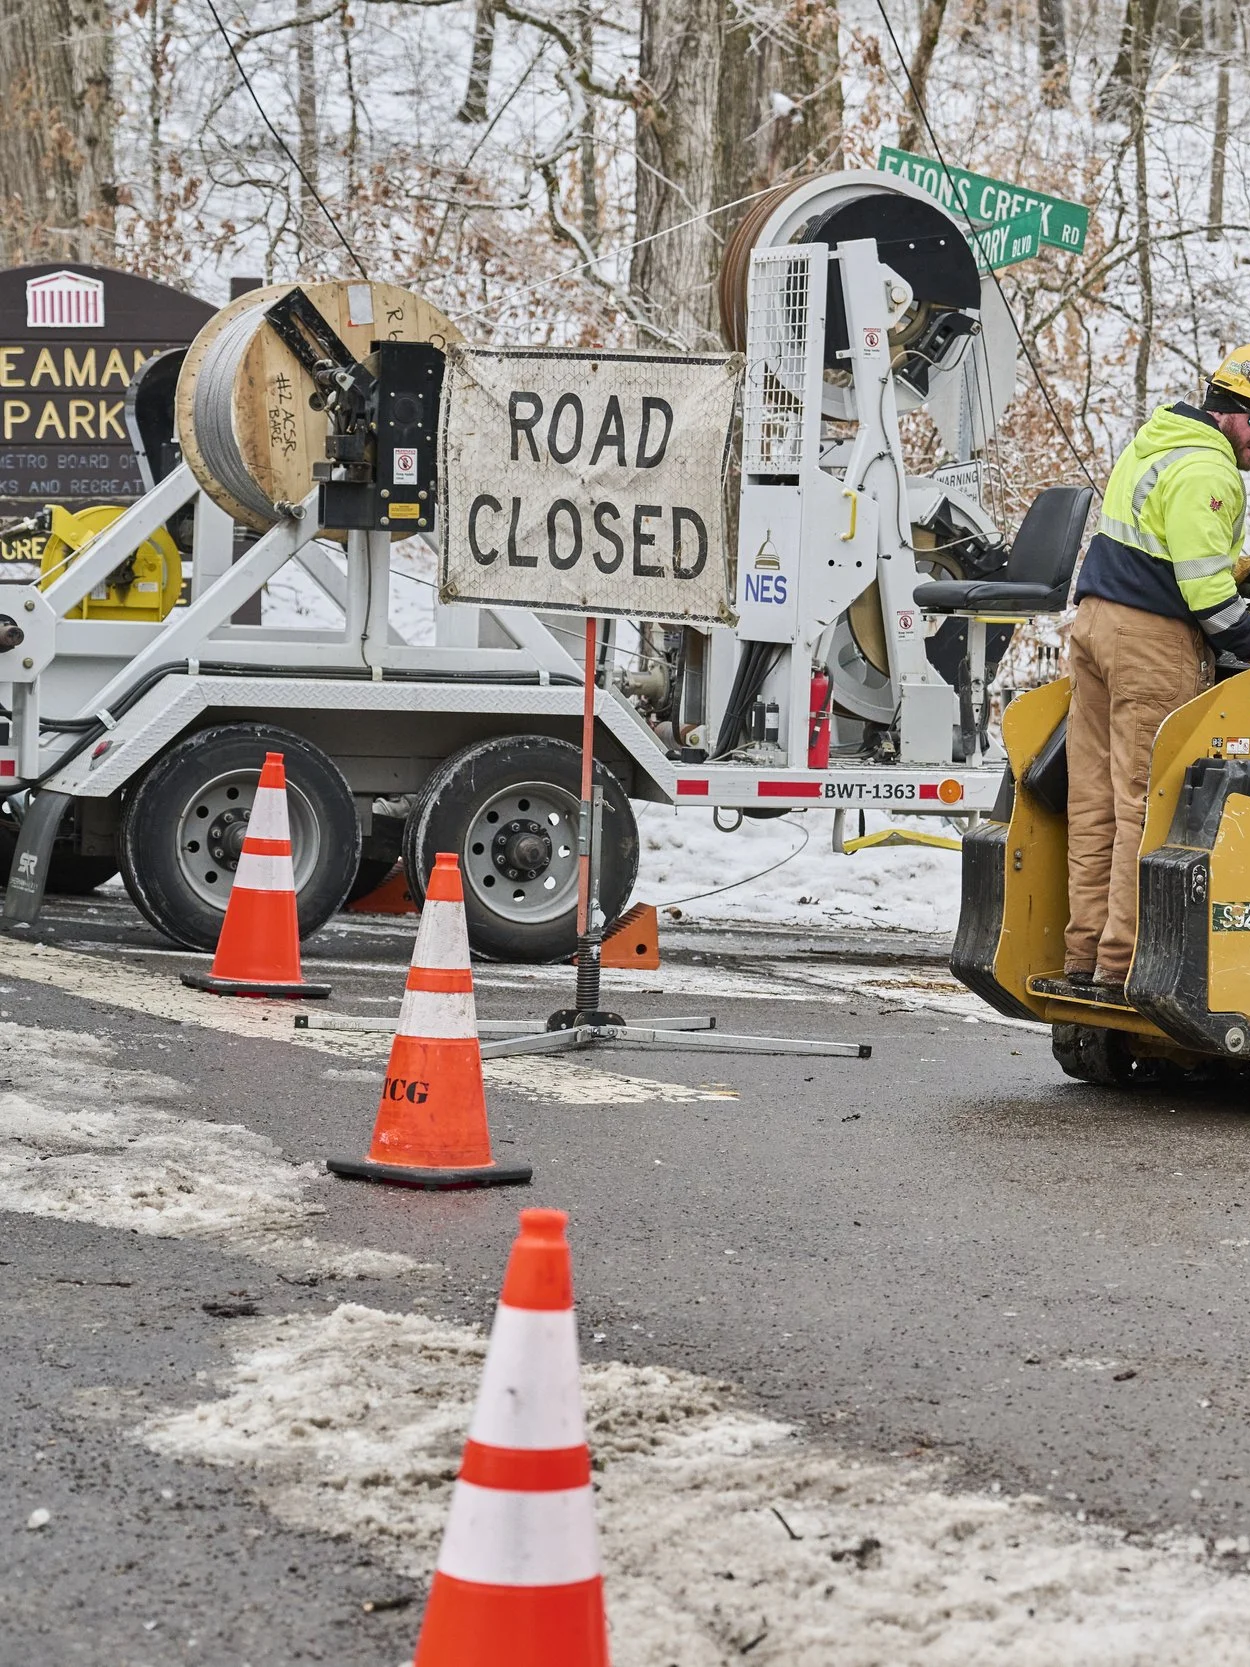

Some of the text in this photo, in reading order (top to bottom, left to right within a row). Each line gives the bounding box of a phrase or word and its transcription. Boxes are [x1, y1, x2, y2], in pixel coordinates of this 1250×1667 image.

[967, 224, 1032, 268] KORY BLVD
[1061, 224, 1080, 245] RD
[386, 307, 404, 324] R
[3, 400, 126, 439] PARK
[268, 405, 283, 448] BARE
[276, 372, 297, 457] #2 ACSR
[508, 390, 674, 469] ROAD
[57, 454, 109, 469] BOARD
[29, 479, 60, 493] AND
[468, 493, 708, 580] CLOSED
[745, 573, 787, 604] NES
[825, 783, 916, 800] BWT-1363
